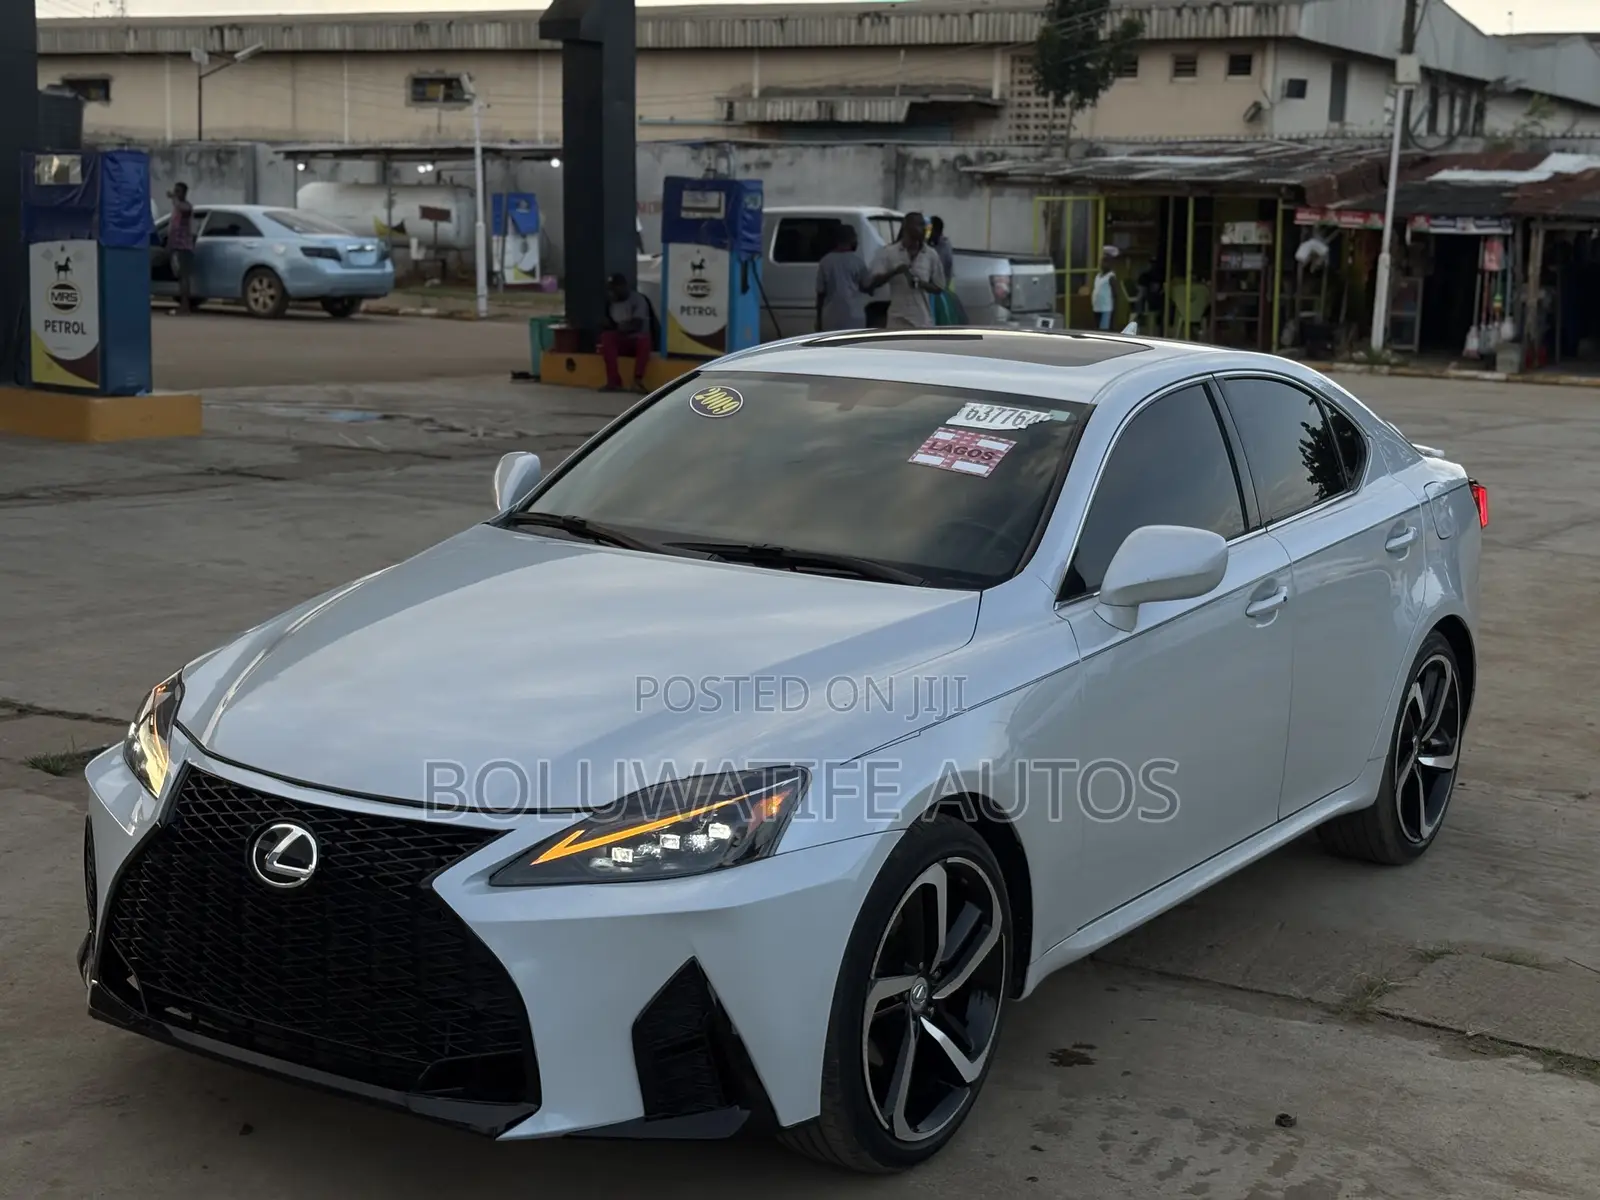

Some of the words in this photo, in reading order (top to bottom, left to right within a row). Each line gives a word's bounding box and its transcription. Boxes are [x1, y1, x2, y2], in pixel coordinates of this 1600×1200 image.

[50, 290, 78, 302] MRS
[680, 306, 718, 317] PETROL
[44, 319, 86, 335] PETROL
[928, 441, 996, 461] LAGOS
